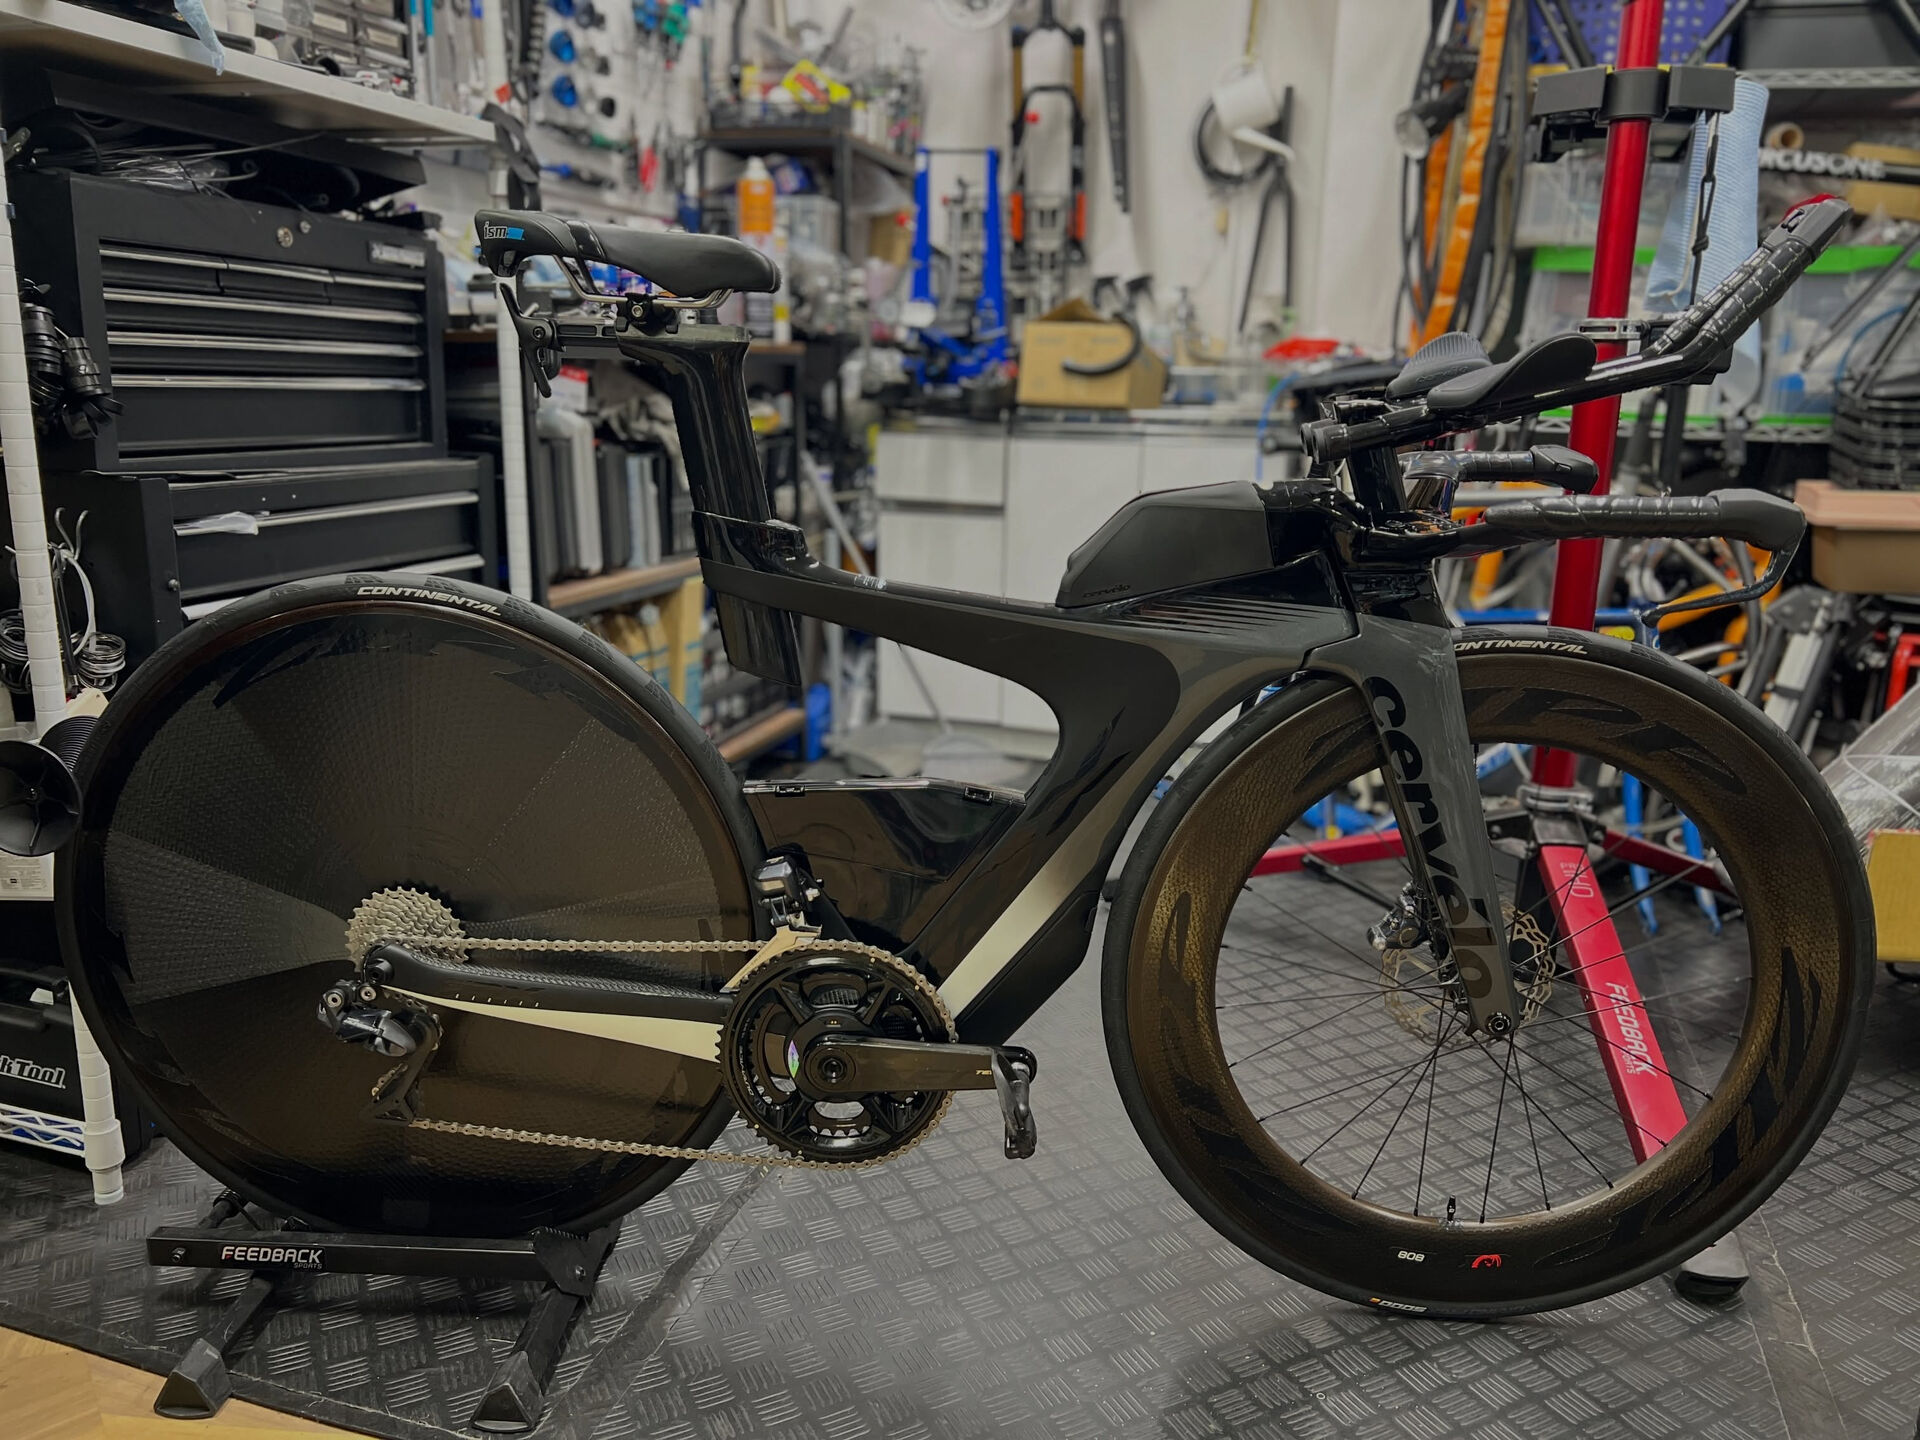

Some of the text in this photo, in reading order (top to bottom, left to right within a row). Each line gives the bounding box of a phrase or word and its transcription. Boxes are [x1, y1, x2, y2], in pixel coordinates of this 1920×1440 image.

[484, 221, 508, 240] ism
[357, 586, 501, 616] CONTINENTAL
[1454, 639, 1587, 655] ONTINENTAL
[1361, 676, 1498, 999] cervélo
[1605, 982, 1658, 1077] FEEDBACK
[222, 1246, 323, 1264] FEEDBACK
[1397, 1250, 1425, 1262] 808
[293, 1262, 323, 1270] SPORTS
